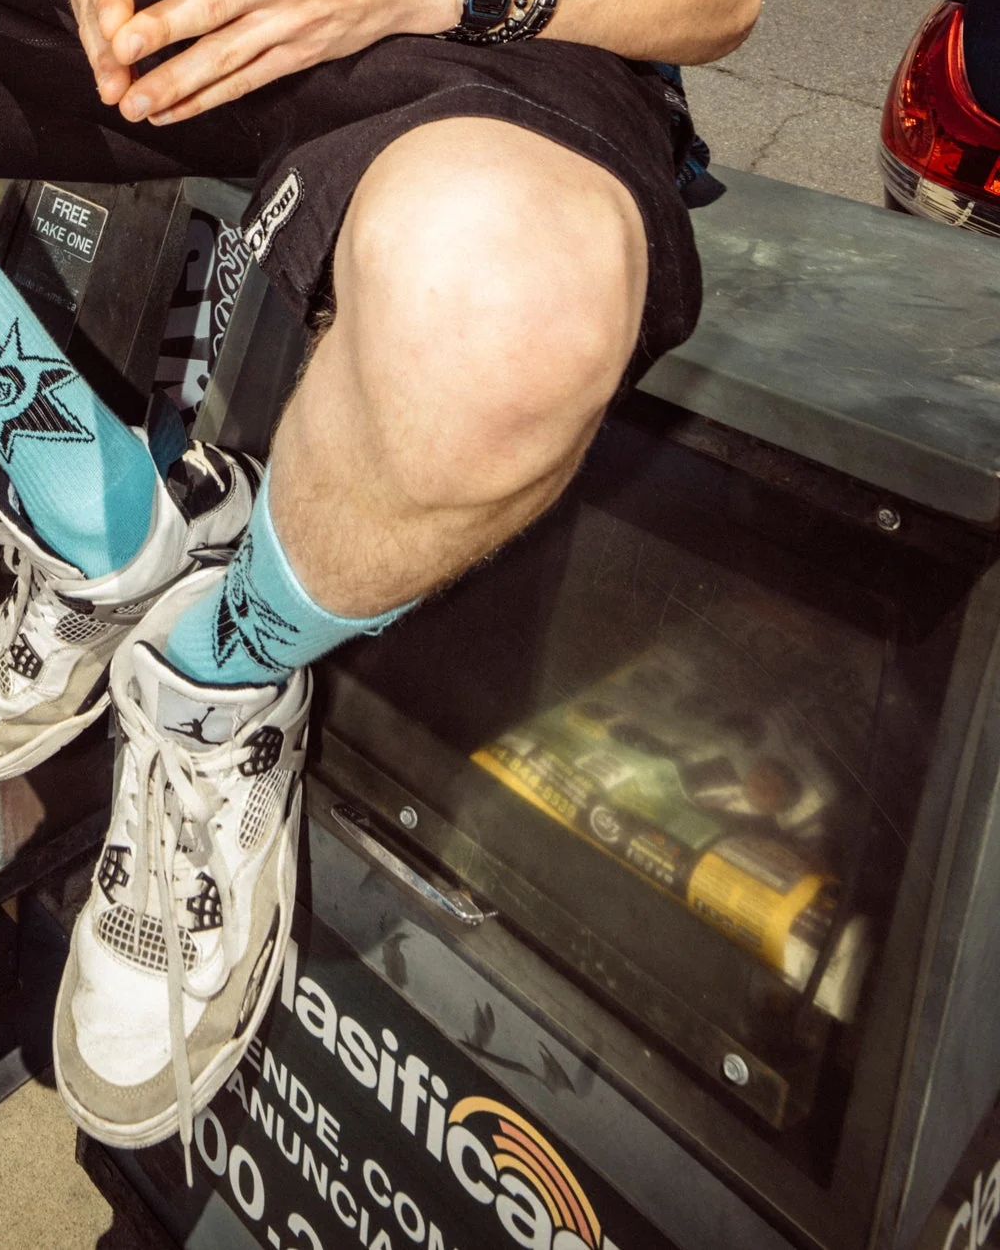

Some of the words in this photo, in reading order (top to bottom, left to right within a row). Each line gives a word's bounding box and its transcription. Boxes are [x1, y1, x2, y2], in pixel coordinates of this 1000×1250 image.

[36, 216, 67, 242] TAKE
[66, 232, 94, 254] ONE
[51, 197, 91, 228] FREE
[250, 185, 295, 251] olcom
[279, 937, 622, 1250] lasifica
